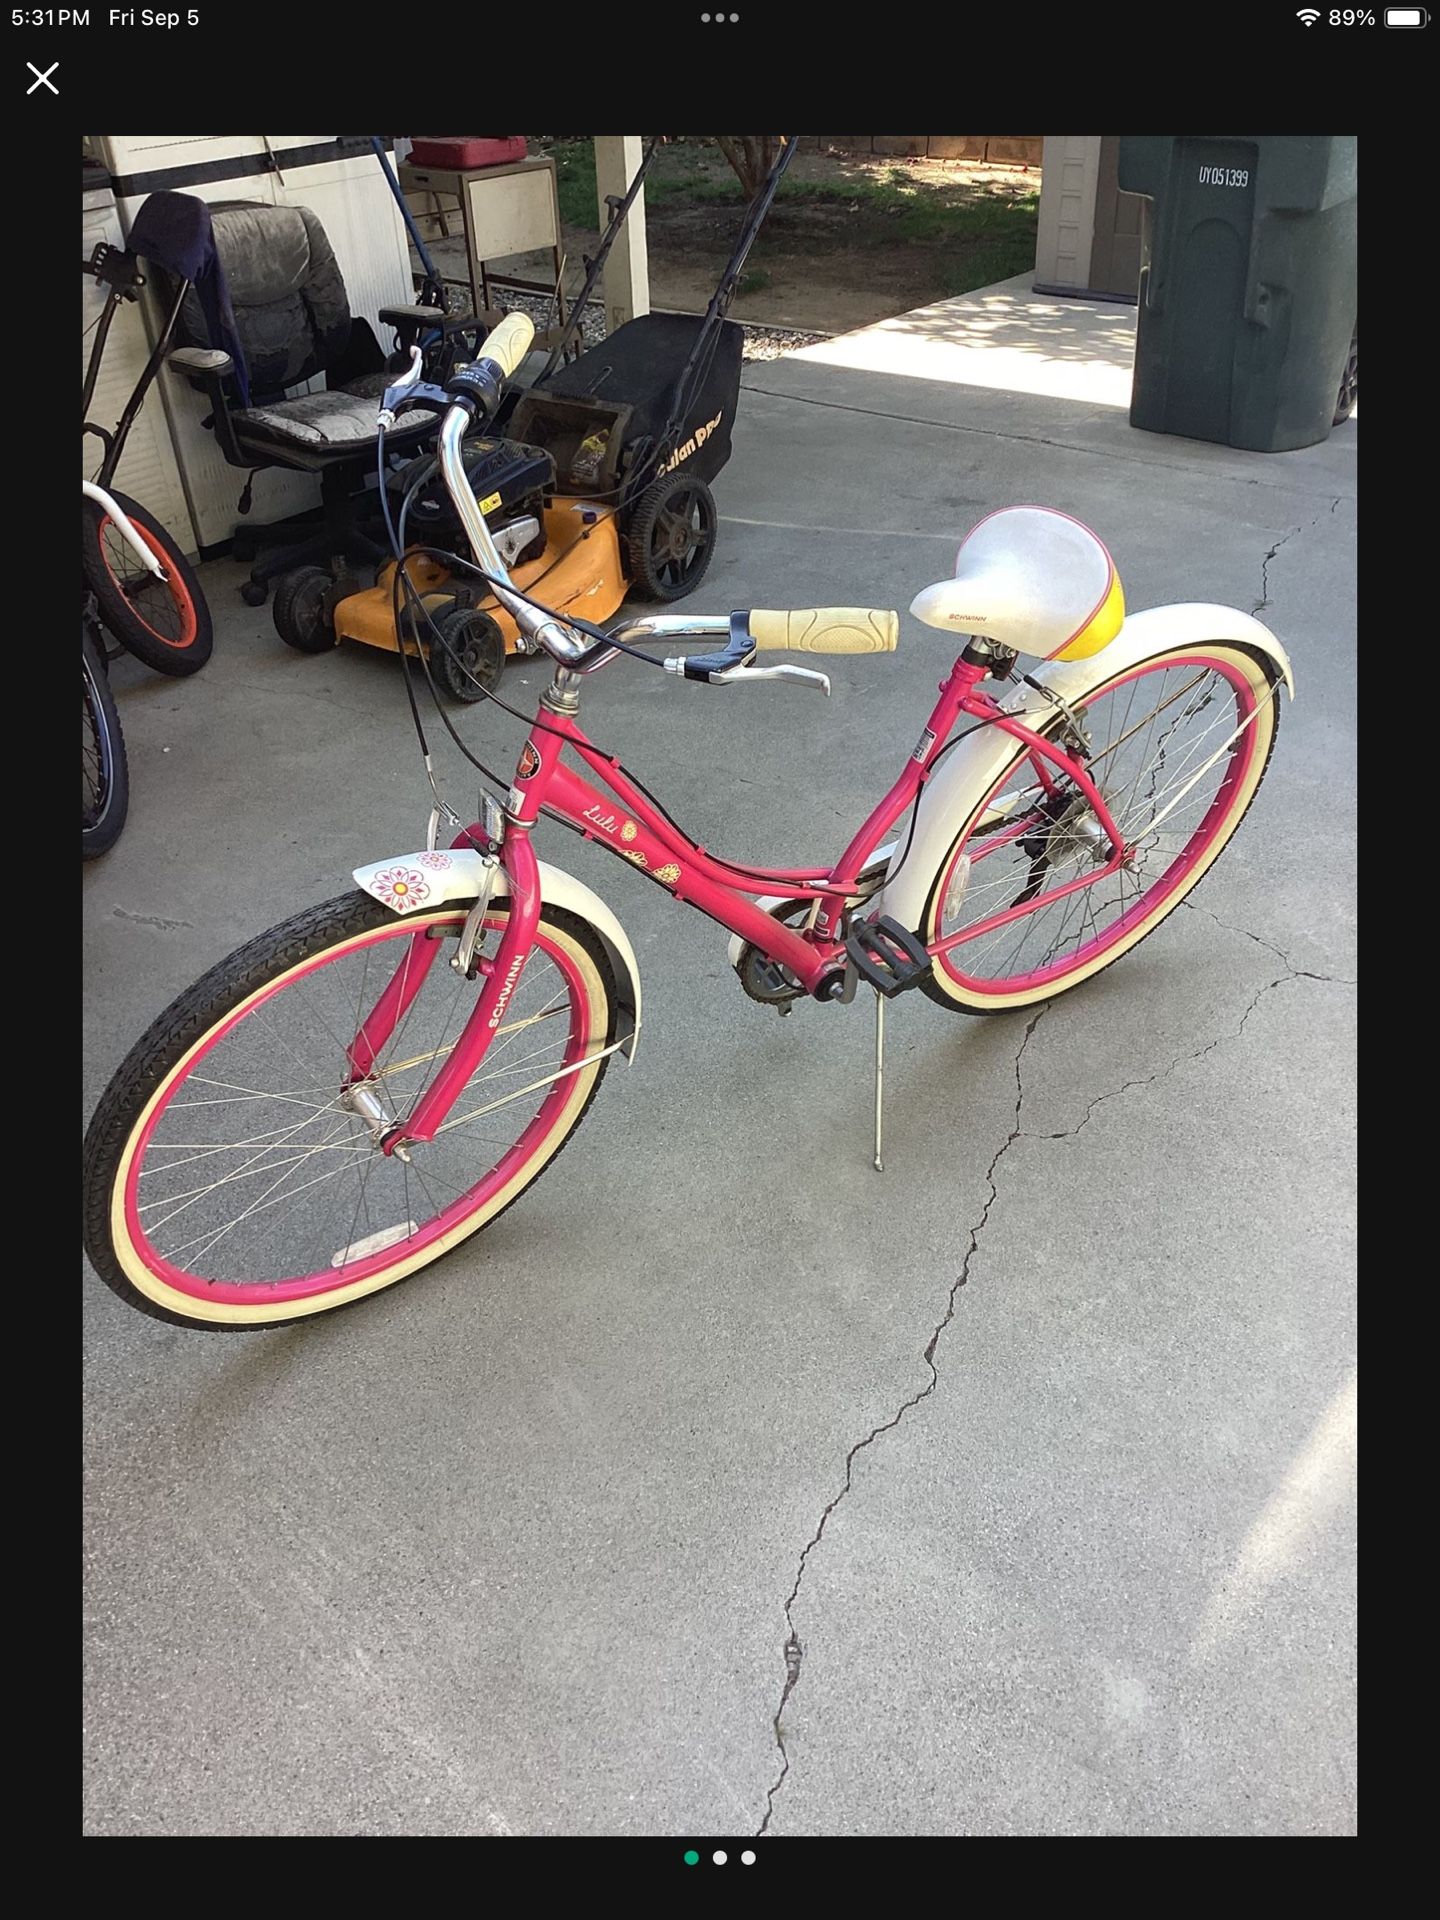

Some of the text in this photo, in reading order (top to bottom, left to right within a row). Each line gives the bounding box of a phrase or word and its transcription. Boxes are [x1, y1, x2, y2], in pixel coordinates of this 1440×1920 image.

[949, 613, 987, 622] SCHWINN
[582, 804, 618, 834] Lulu
[488, 954, 525, 1028] SCHWINN
